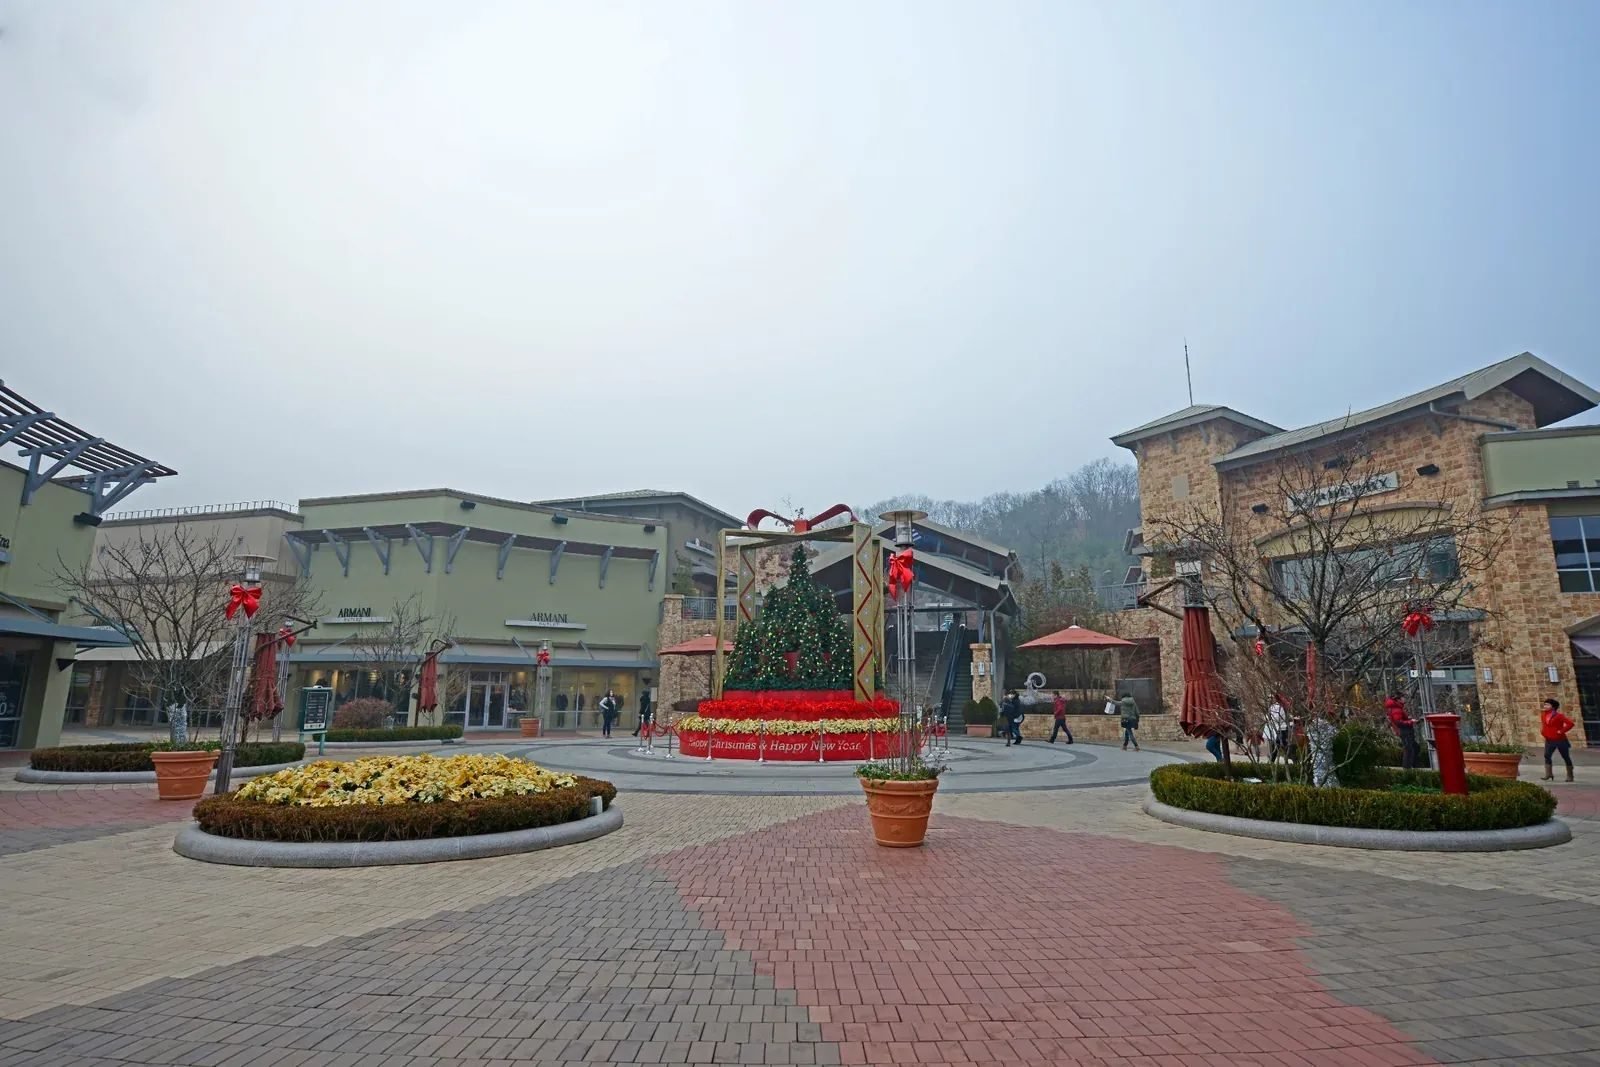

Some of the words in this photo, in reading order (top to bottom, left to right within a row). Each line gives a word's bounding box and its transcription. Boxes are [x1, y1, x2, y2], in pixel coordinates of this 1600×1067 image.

[338, 607, 371, 617] ARMANI
[530, 612, 568, 624] ARMANI
[711, 738, 757, 751] Christmas
[770, 739, 808, 754] Happy
[810, 740, 836, 751] New
[838, 740, 861, 751] Year
